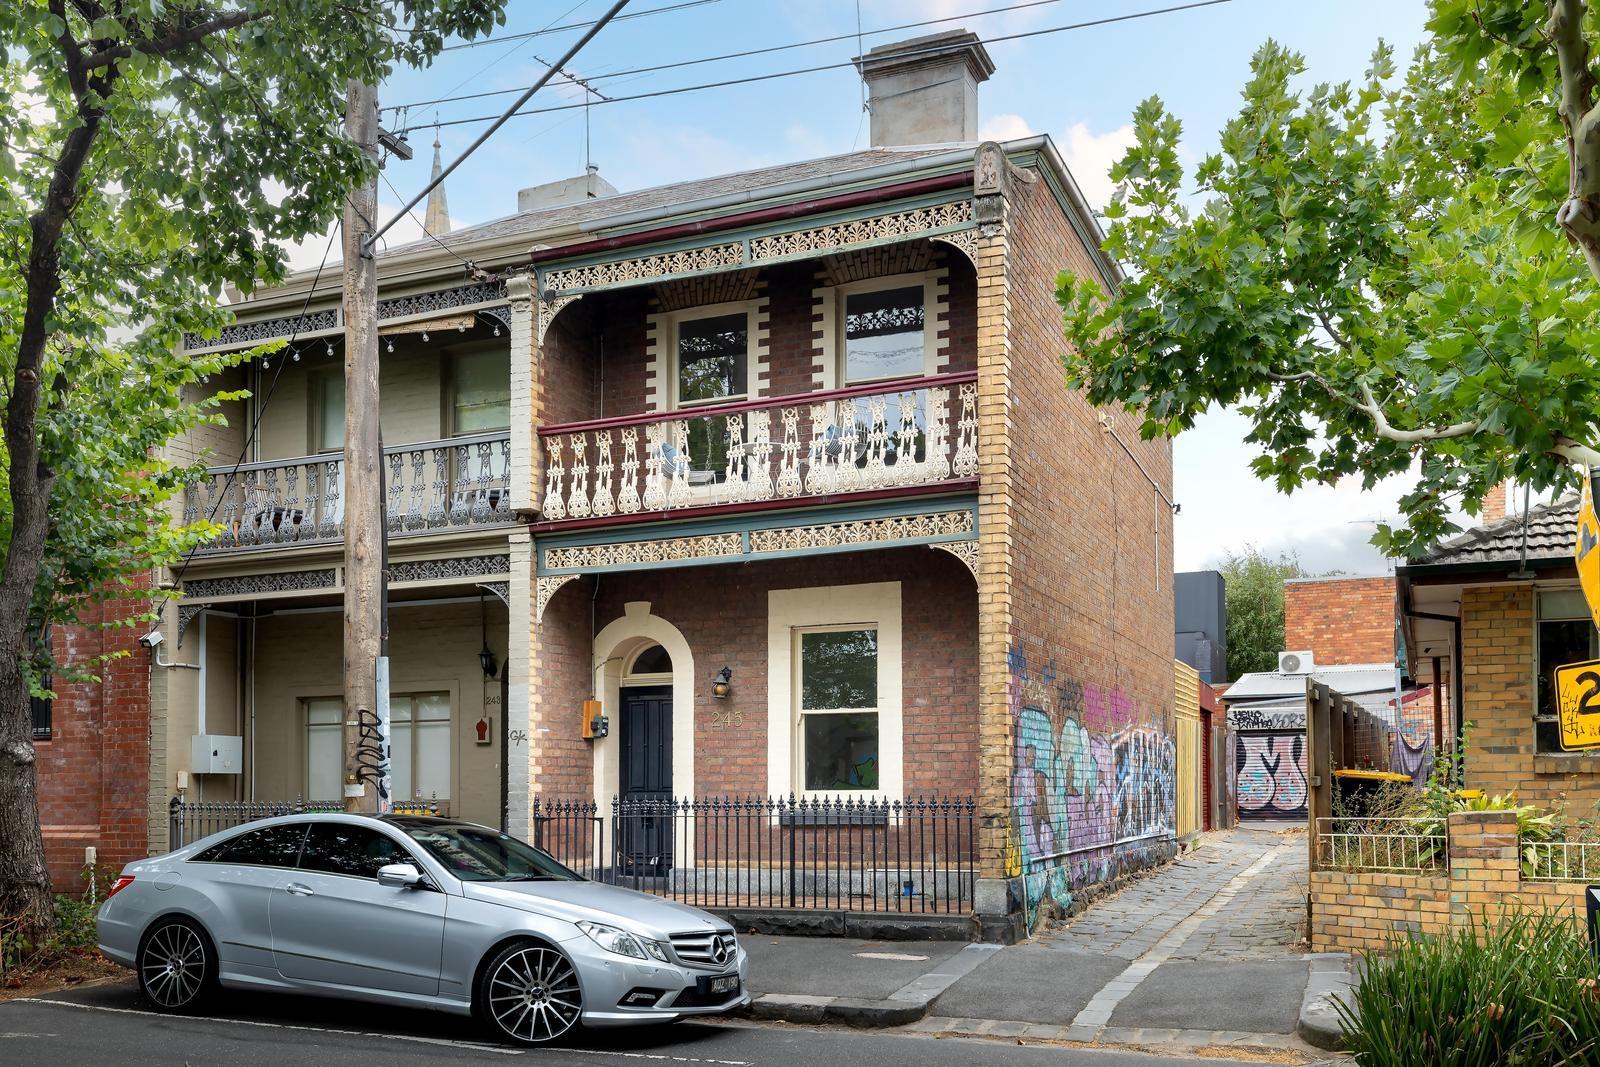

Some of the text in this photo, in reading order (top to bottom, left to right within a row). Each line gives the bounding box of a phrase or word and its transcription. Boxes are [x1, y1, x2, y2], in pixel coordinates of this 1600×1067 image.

[486, 696, 501, 705] 243
[1575, 671, 1600, 715] 2
[711, 711, 743, 728] 245
